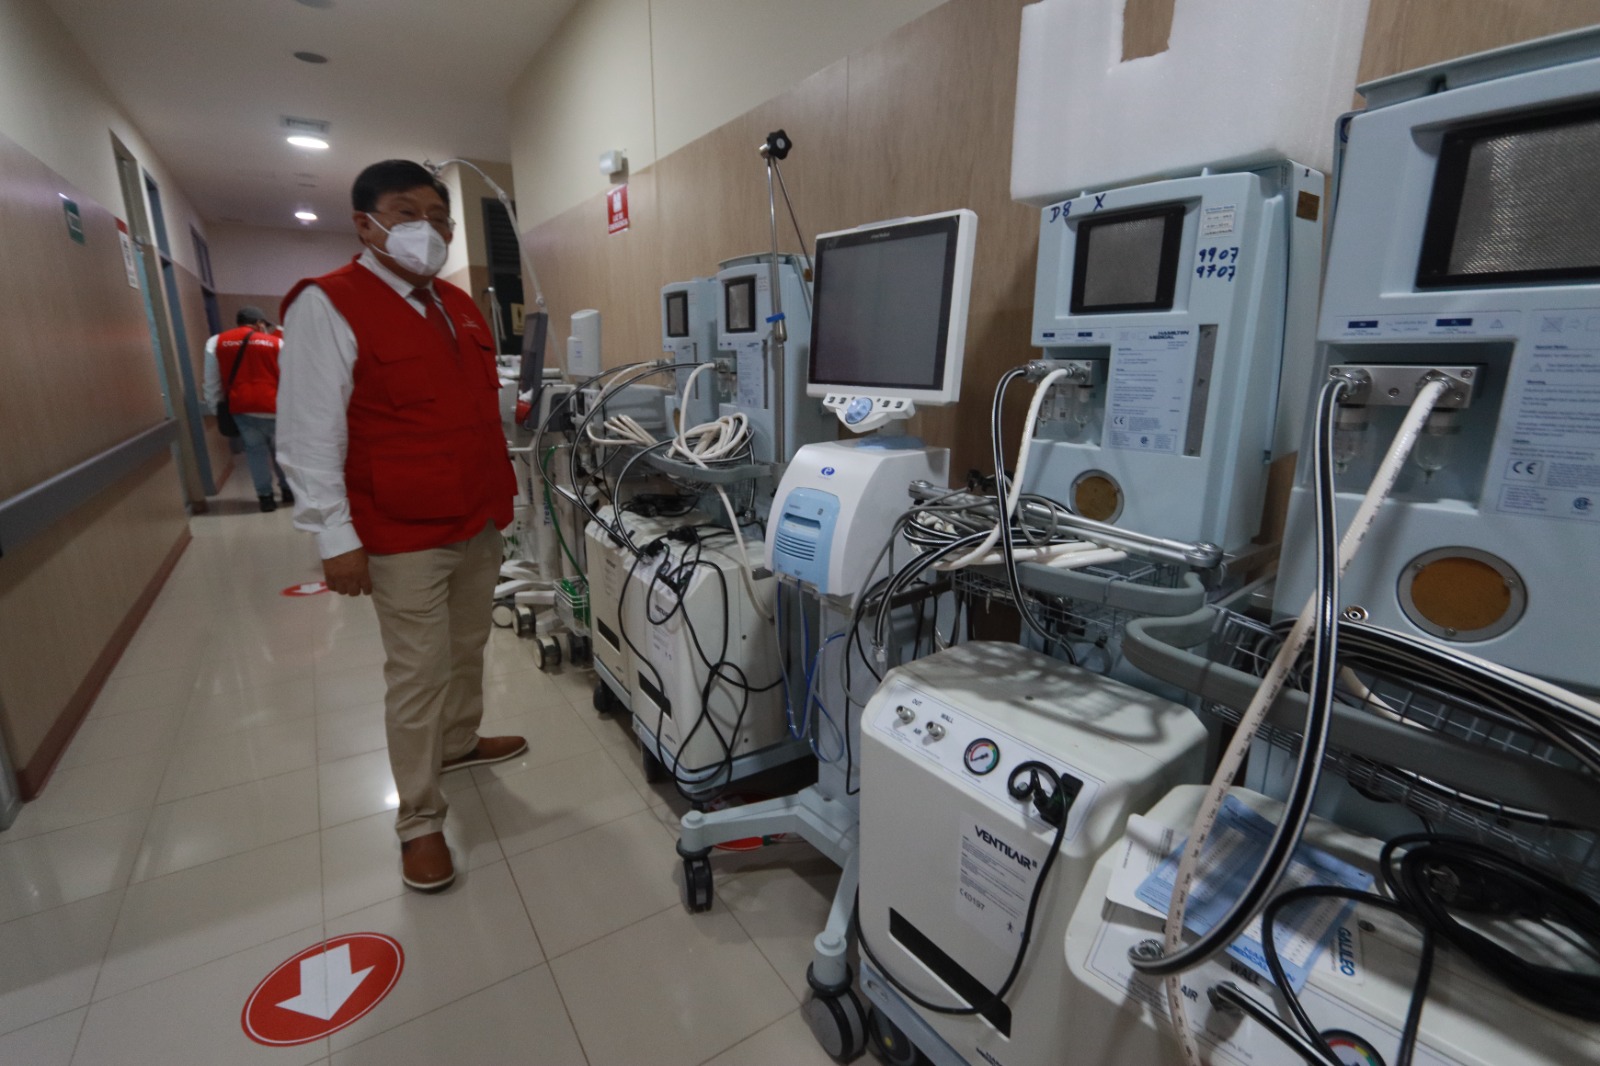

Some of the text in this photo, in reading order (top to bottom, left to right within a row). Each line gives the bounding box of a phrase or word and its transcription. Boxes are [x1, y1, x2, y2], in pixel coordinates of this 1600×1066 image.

[974, 825, 1031, 871] VENTILAIR
[1338, 927, 1355, 976] GALILEO
[1230, 961, 1260, 986] WALL
[1181, 985, 1199, 1002] AIR
